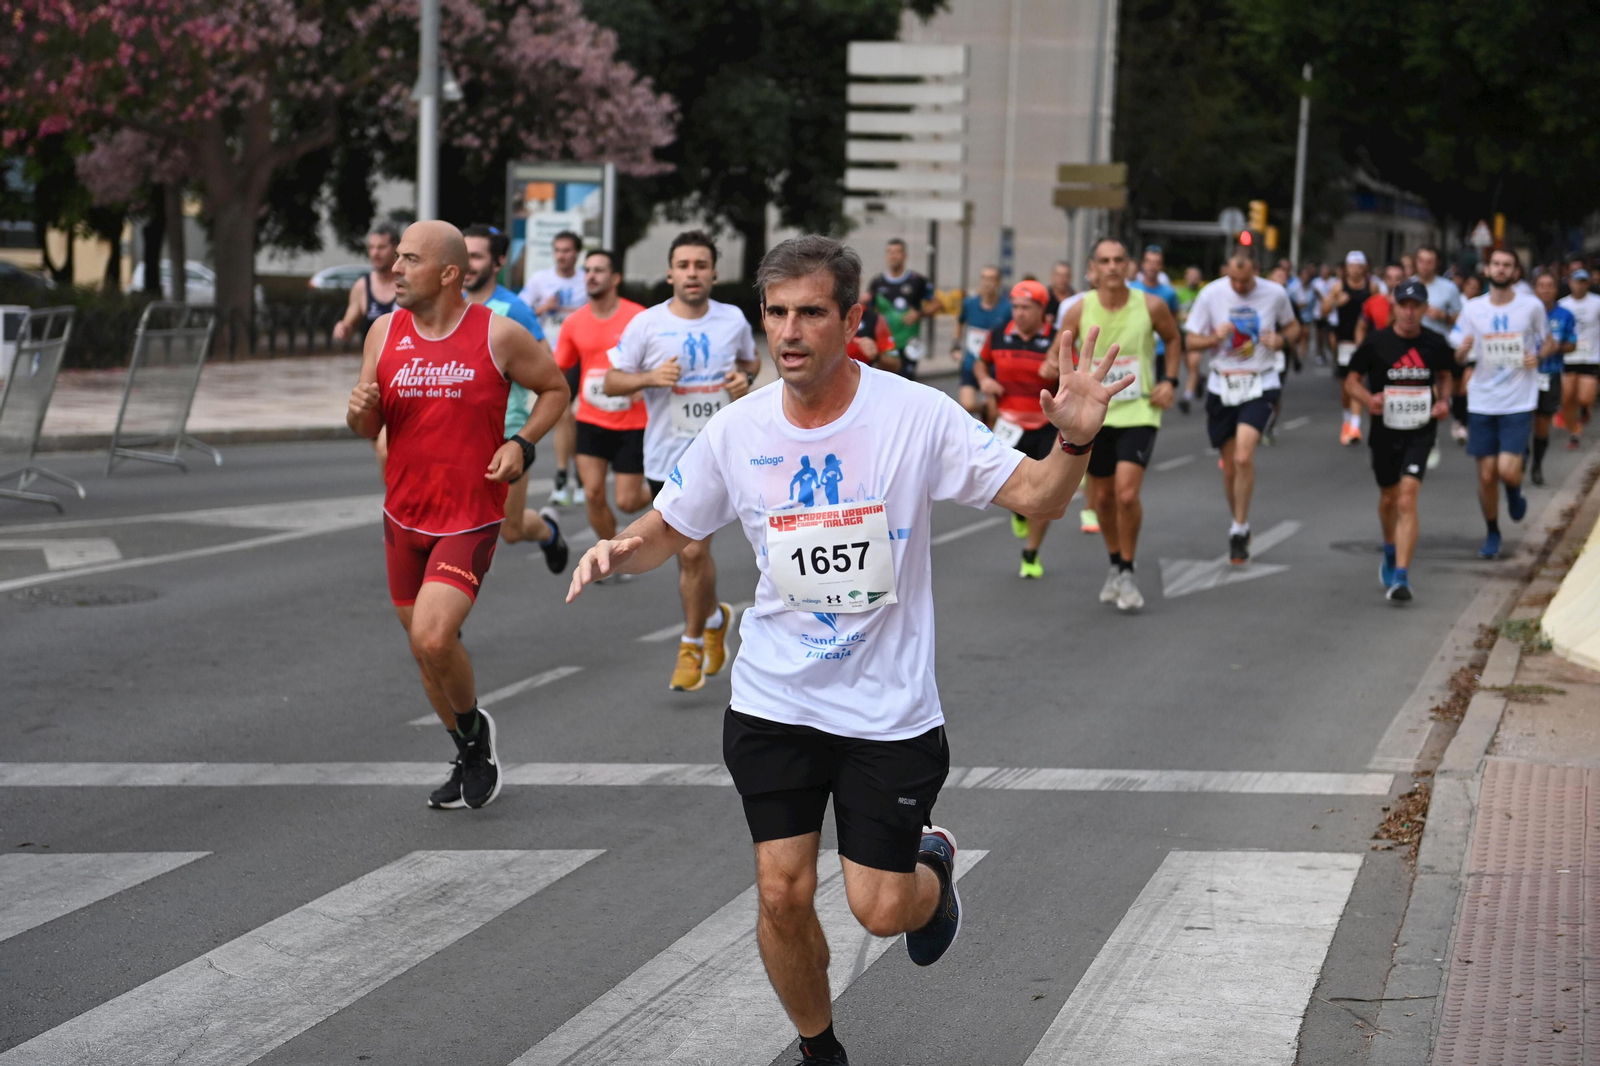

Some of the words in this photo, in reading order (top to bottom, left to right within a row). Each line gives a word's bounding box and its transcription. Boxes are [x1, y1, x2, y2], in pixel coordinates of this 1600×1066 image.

[390, 363, 437, 388] Álora
[410, 358, 475, 377] Triatlón
[1387, 366, 1430, 380] adidas
[397, 388, 423, 398] Valle
[426, 388, 442, 397] del
[445, 388, 461, 398] Sol
[683, 401, 721, 418] 1091
[769, 514, 797, 532] 42
[797, 511, 839, 522] CARRERA
[791, 541, 870, 576] 1657
